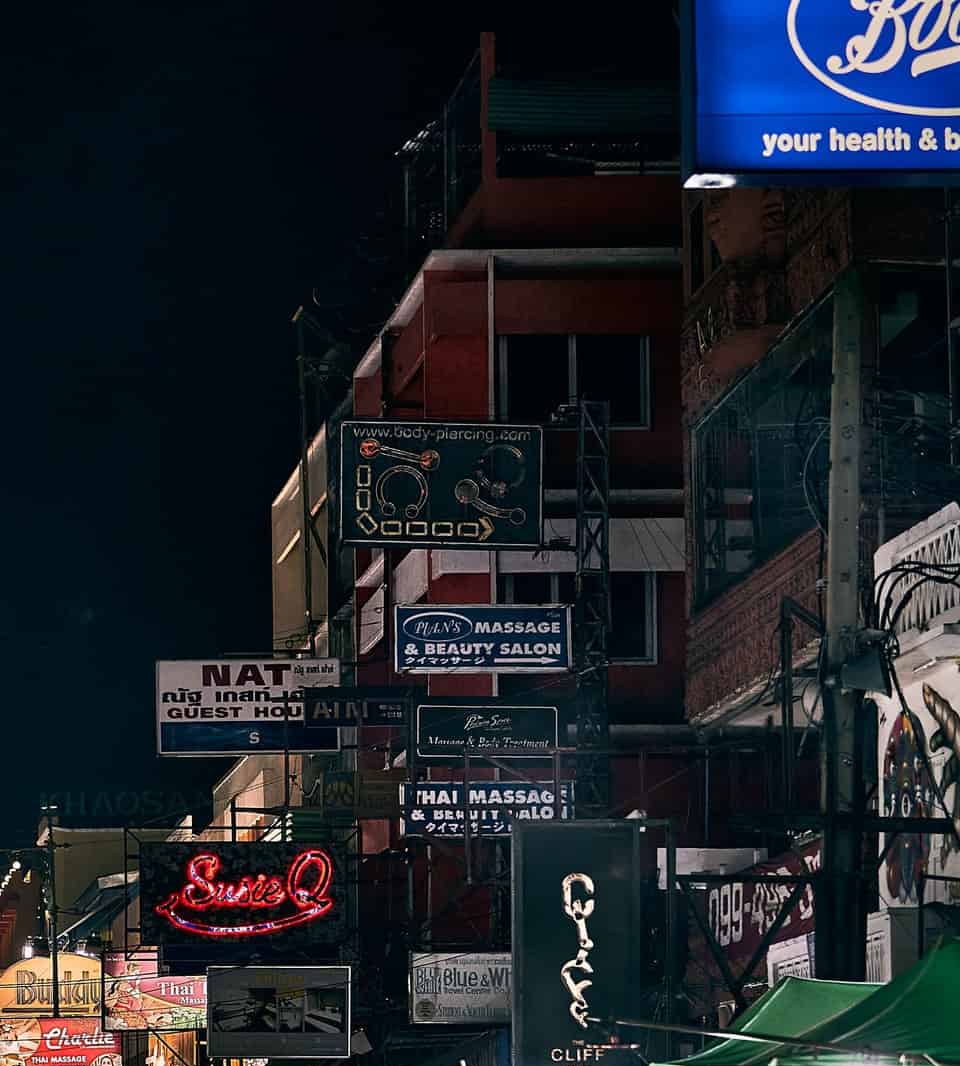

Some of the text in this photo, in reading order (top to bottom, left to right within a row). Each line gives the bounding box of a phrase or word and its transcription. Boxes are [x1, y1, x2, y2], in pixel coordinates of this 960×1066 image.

[762, 132, 822, 157] your
[830, 128, 910, 152] health
[919, 128, 938, 151] &
[352, 425, 532, 444] www.body-piercing.com
[474, 621, 561, 634] MASSAGE
[404, 643, 561, 656] & BEAUTY SALON
[202, 664, 292, 687] NAT
[167, 707, 243, 720] GUEST
[249, 732, 261, 745] S
[416, 790, 568, 805] THAI MASSAGE
[410, 809, 427, 821] &
[181, 846, 334, 911] Susie Q
[443, 967, 478, 987] Blue
[157, 982, 194, 996] Thai
[43, 1026, 115, 1050] Charlie
[32, 1055, 87, 1064] THAI MASSAGE
[551, 1048, 606, 1062] CLIFF
